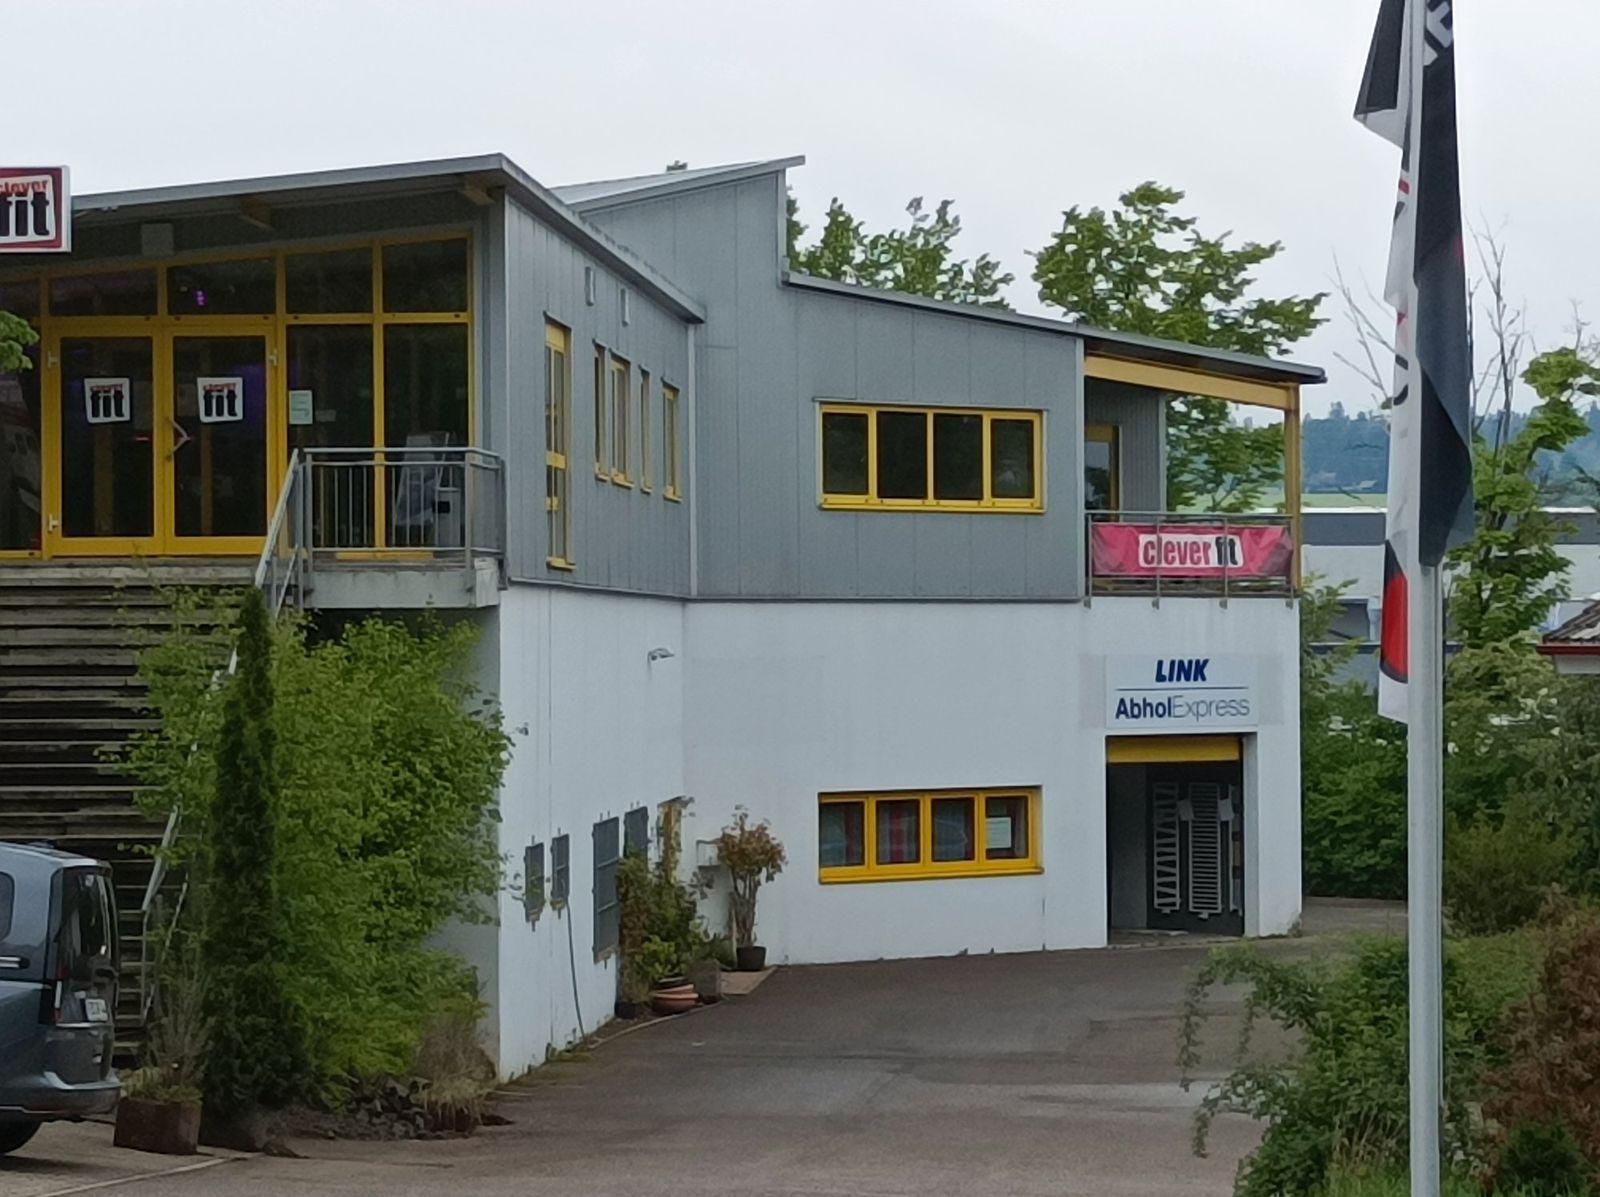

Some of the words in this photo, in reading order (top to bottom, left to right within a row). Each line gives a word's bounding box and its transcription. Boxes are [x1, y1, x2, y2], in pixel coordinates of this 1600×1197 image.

[90, 390, 125, 418] fit
[203, 389, 238, 418] fit
[1143, 536, 1212, 566] clever
[1155, 658, 1210, 683] LINK
[1115, 695, 1250, 722] AbholExpress
